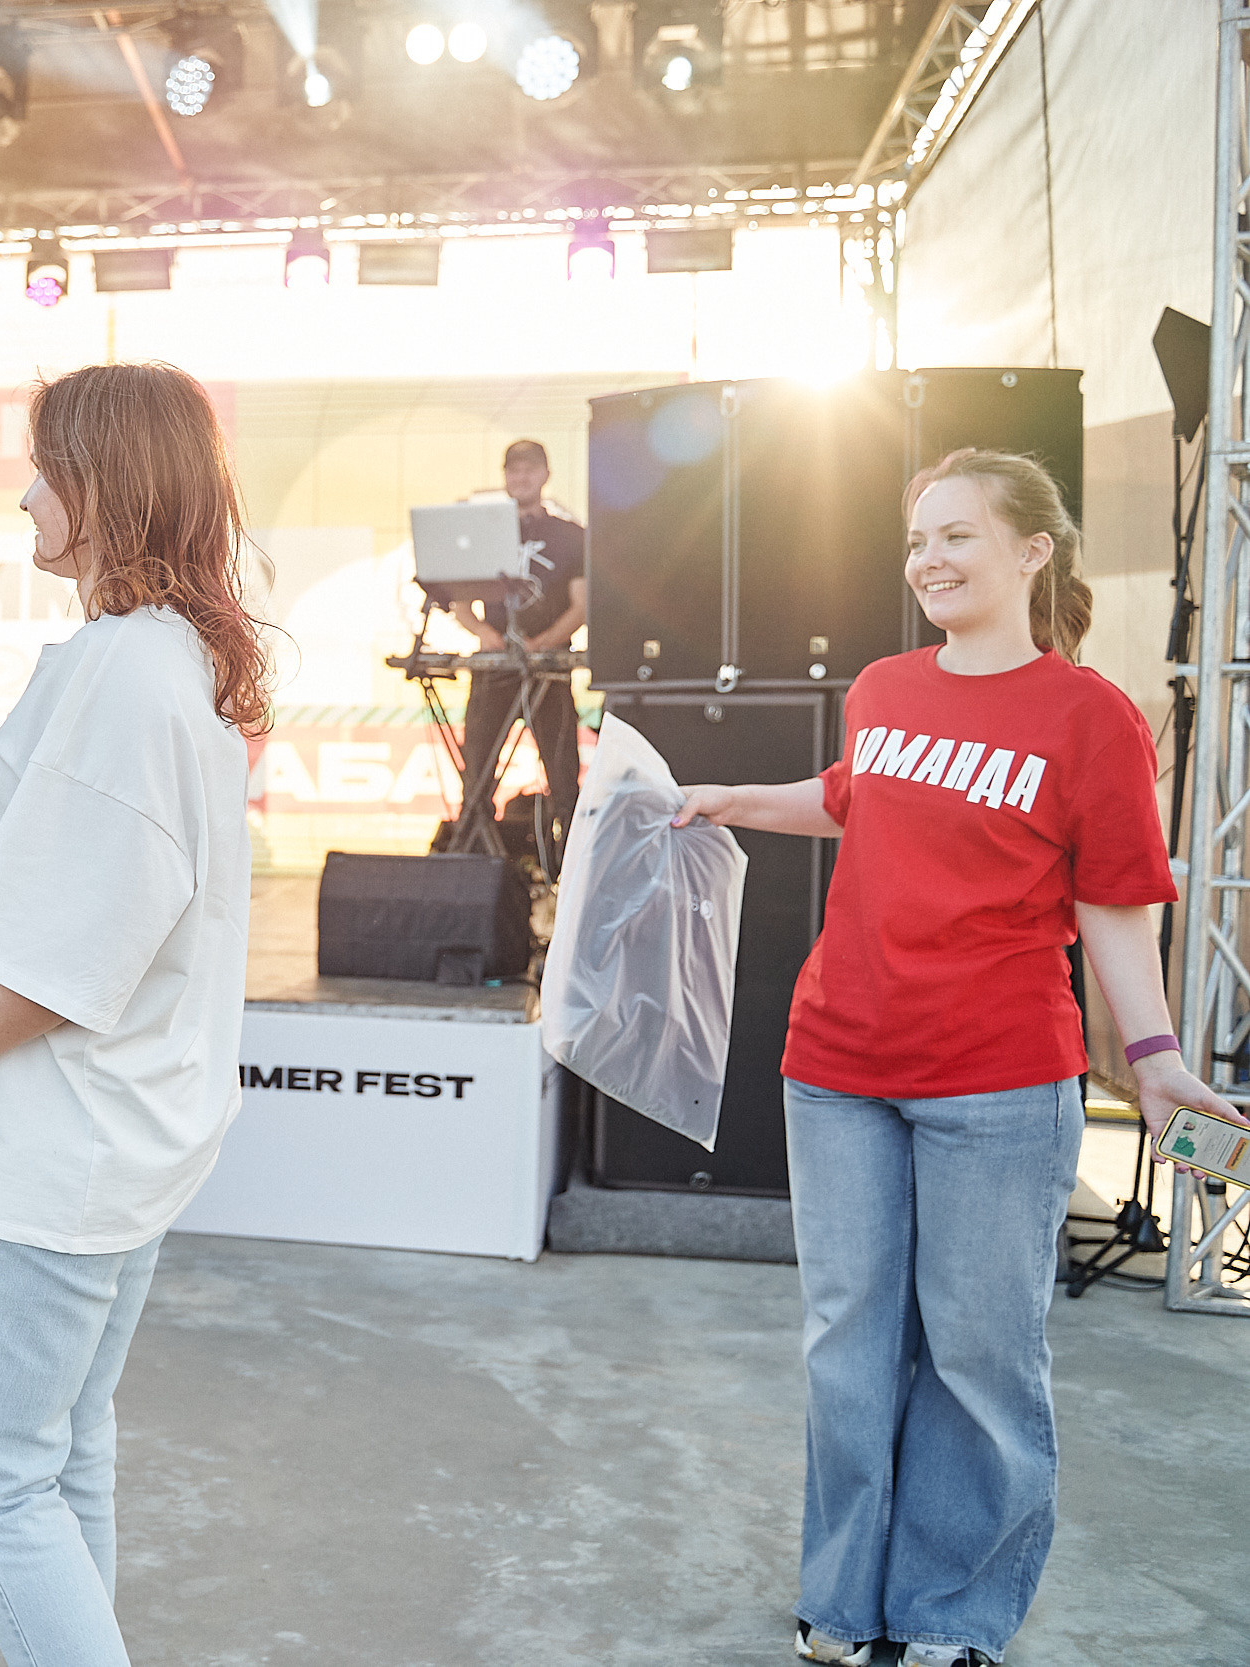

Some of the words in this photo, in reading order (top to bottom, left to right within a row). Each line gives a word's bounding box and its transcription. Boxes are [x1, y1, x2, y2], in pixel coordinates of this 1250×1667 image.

[852, 726, 1048, 814] ОМАНДА
[239, 1064, 343, 1093] MER
[356, 1070, 474, 1100] FEST
